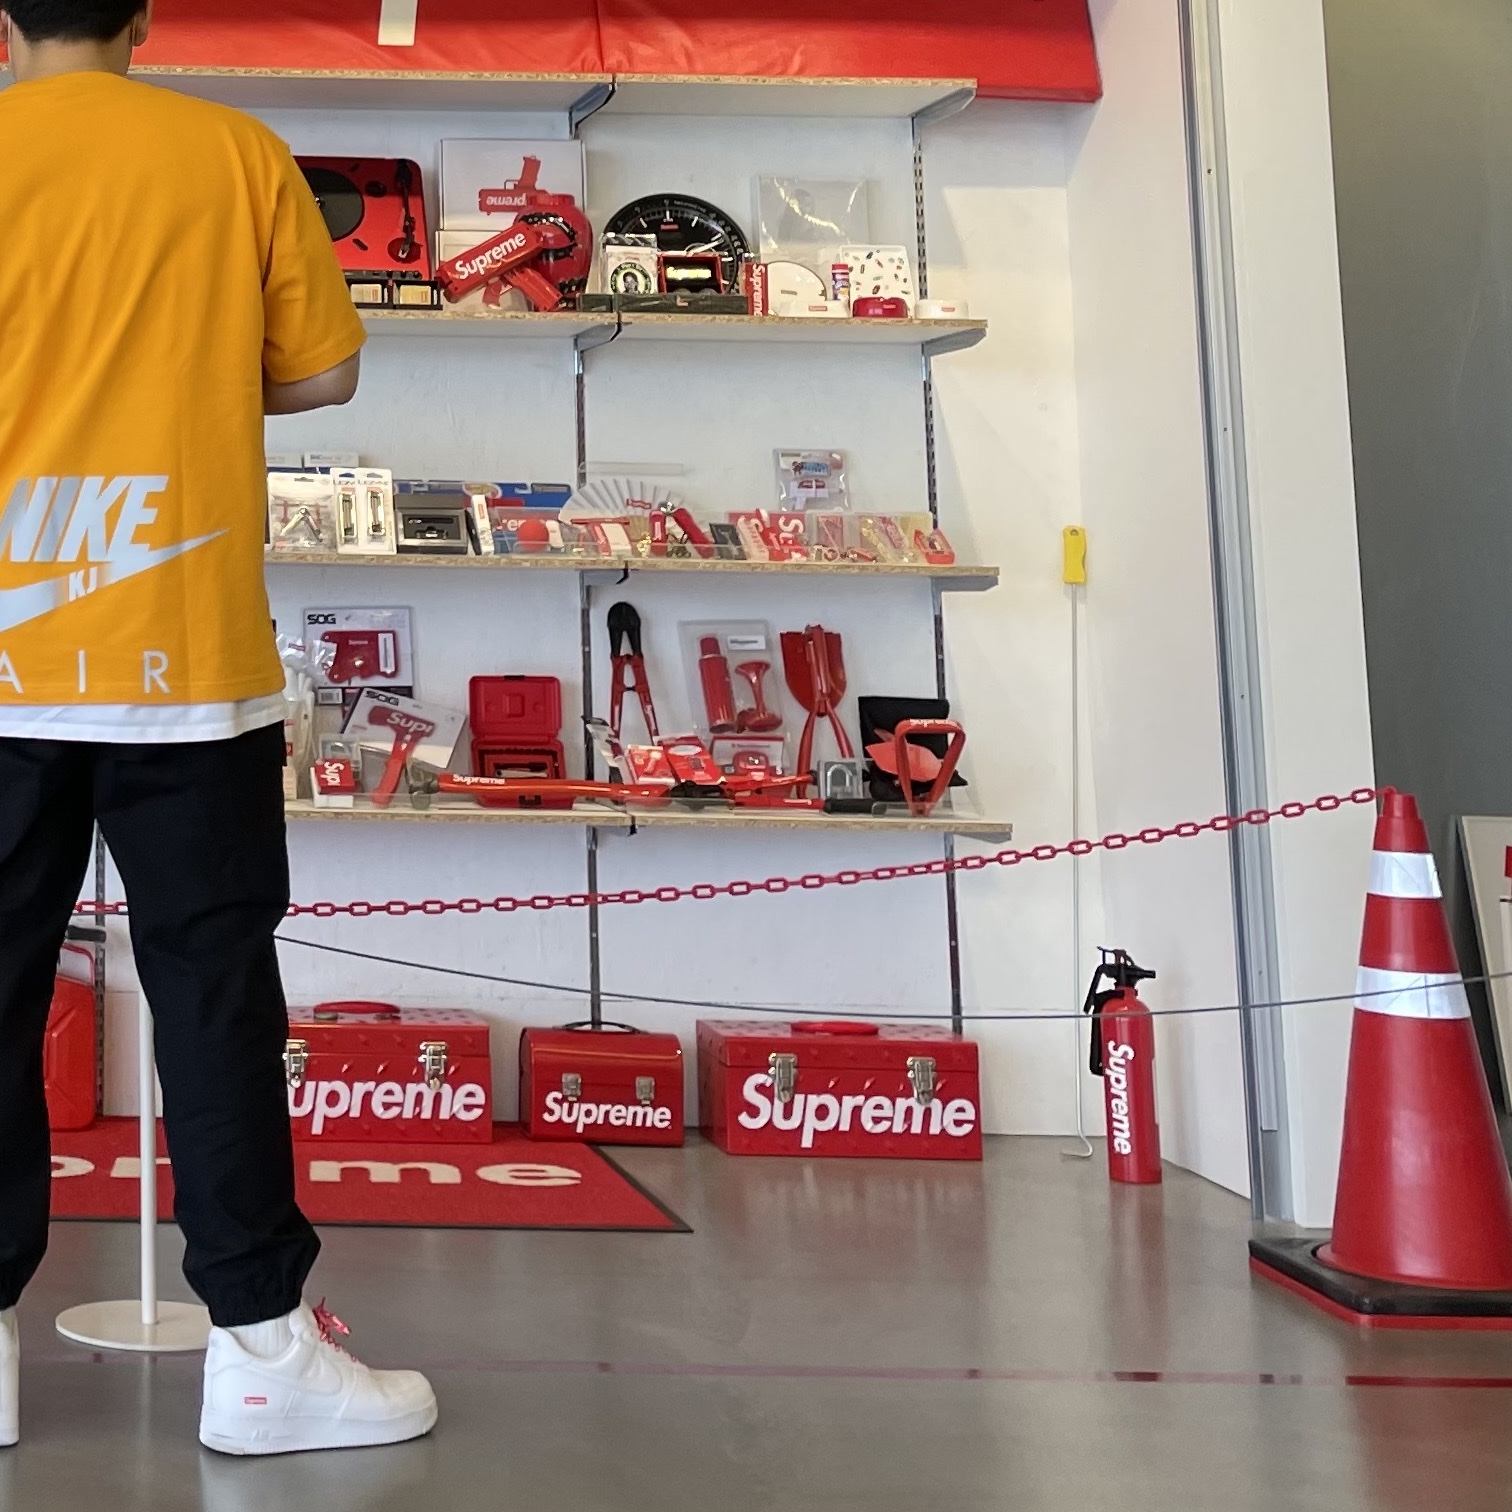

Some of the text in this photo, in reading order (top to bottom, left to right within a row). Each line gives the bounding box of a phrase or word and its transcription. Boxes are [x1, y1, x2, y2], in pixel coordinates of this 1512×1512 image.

[486, 193, 528, 206] preme
[455, 232, 527, 280] Supreme
[307, 614, 336, 625] SOG
[288, 1080, 486, 1136] upreme
[541, 1091, 672, 1134] Supreme
[737, 1073, 976, 1148] Supreme
[1113, 1039, 1136, 1155] Supreme
